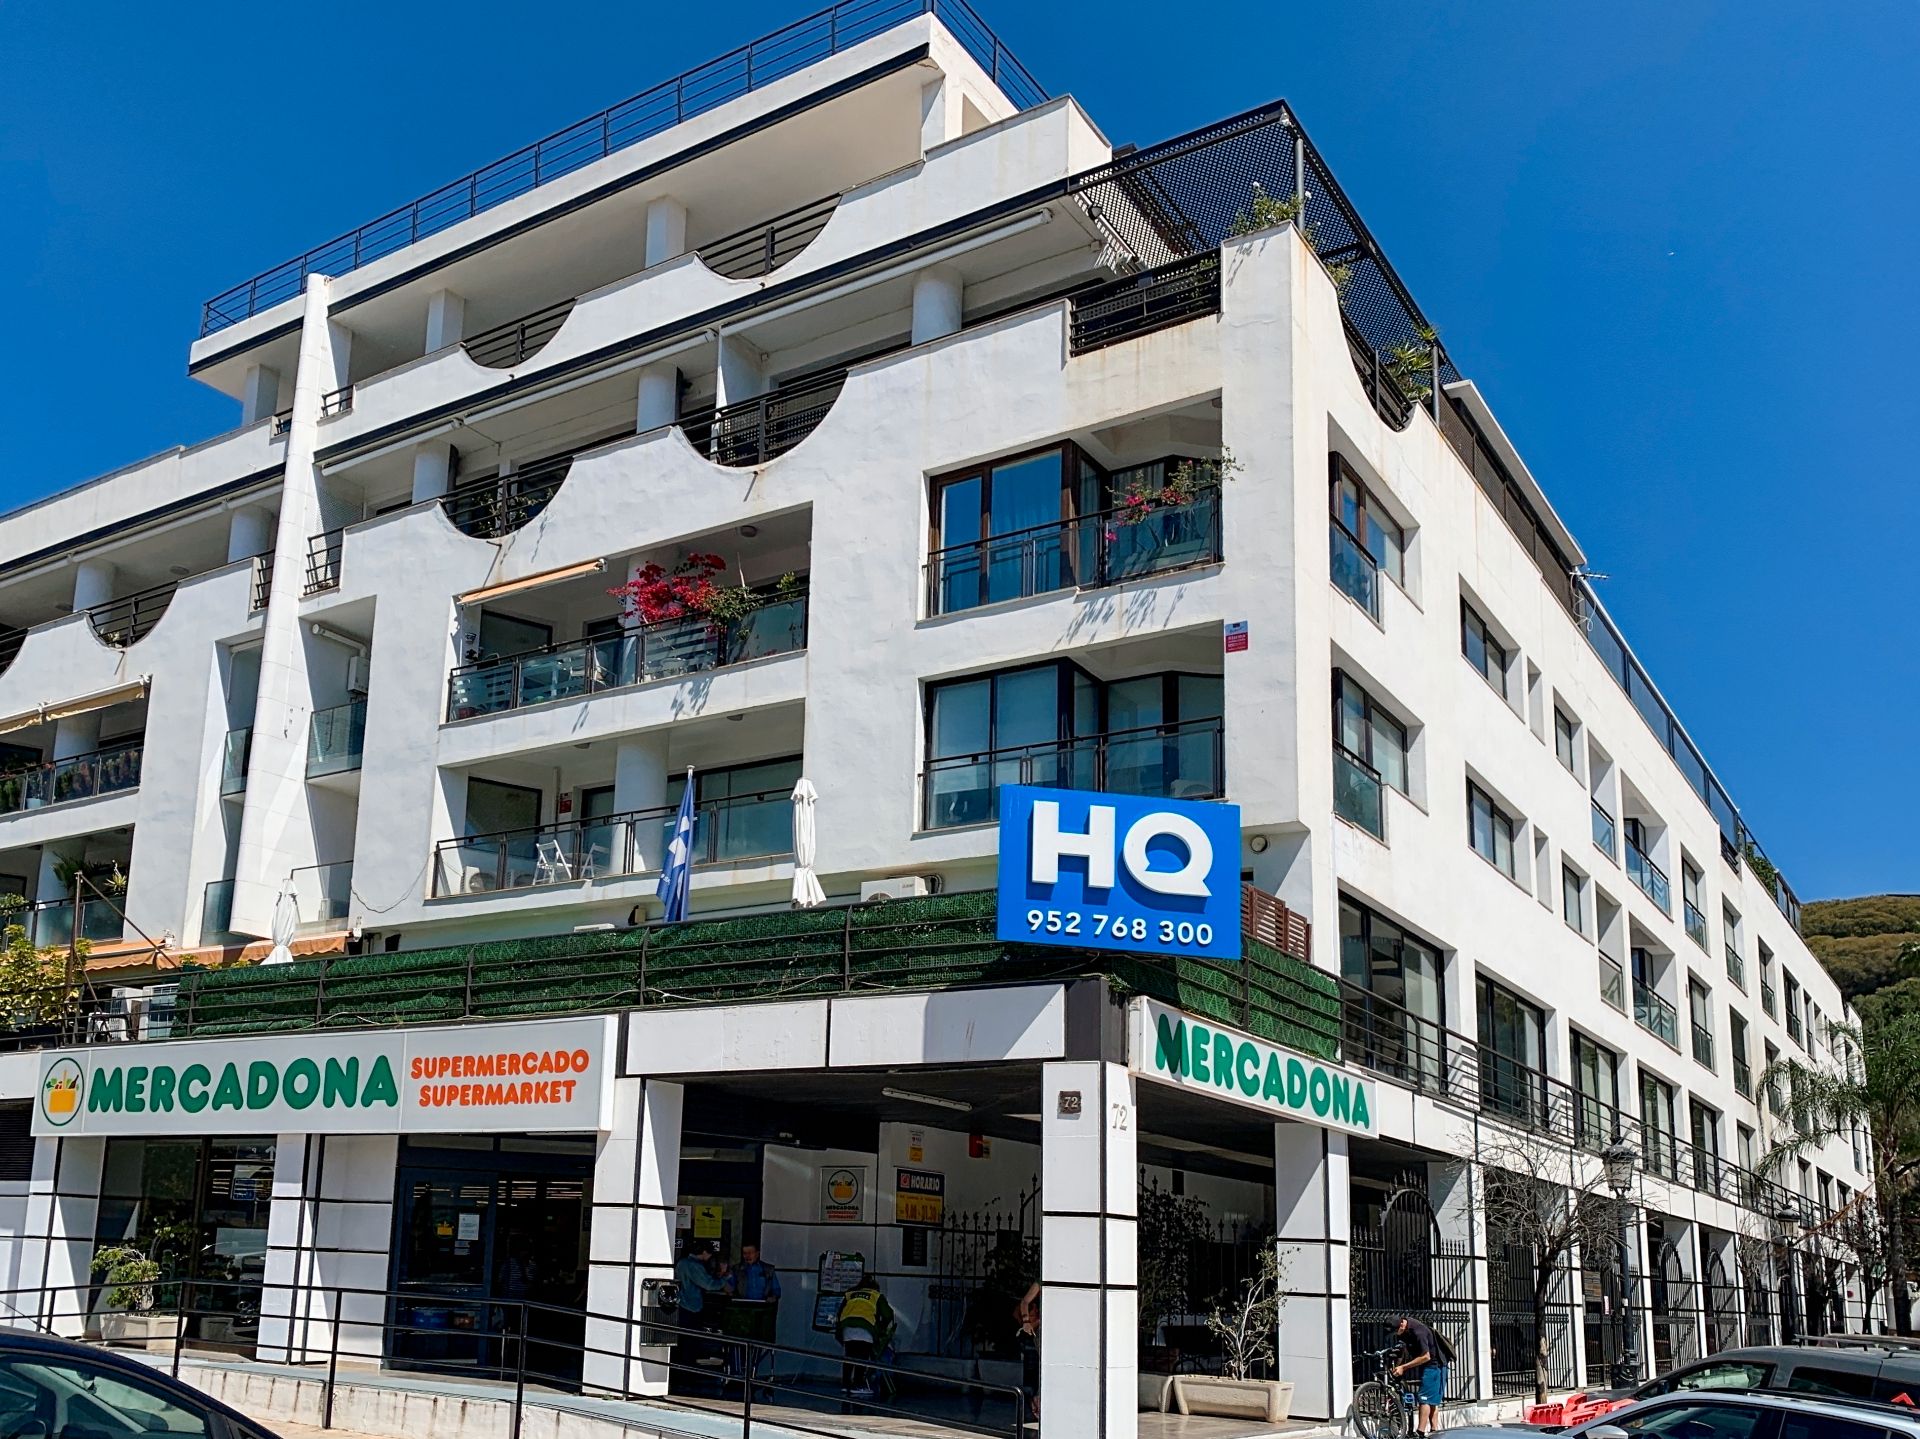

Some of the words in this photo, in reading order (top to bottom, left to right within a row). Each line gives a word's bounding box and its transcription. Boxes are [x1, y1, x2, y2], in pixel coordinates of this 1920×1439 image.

[1032, 800, 1213, 897] HQ
[1026, 910, 1081, 934] 952
[1092, 914, 1147, 940] 768
[1159, 920, 1213, 945] 300
[410, 1049, 589, 1079] SUPERMERCADO
[1155, 1013, 1369, 1129] MERCADONA
[88, 1055, 398, 1113] MERCADONA
[419, 1080, 576, 1107] SUPERMARKET
[1064, 1096, 1079, 1108] 72
[1111, 1103, 1128, 1131] 72
[910, 1175, 940, 1191] HORARIO
